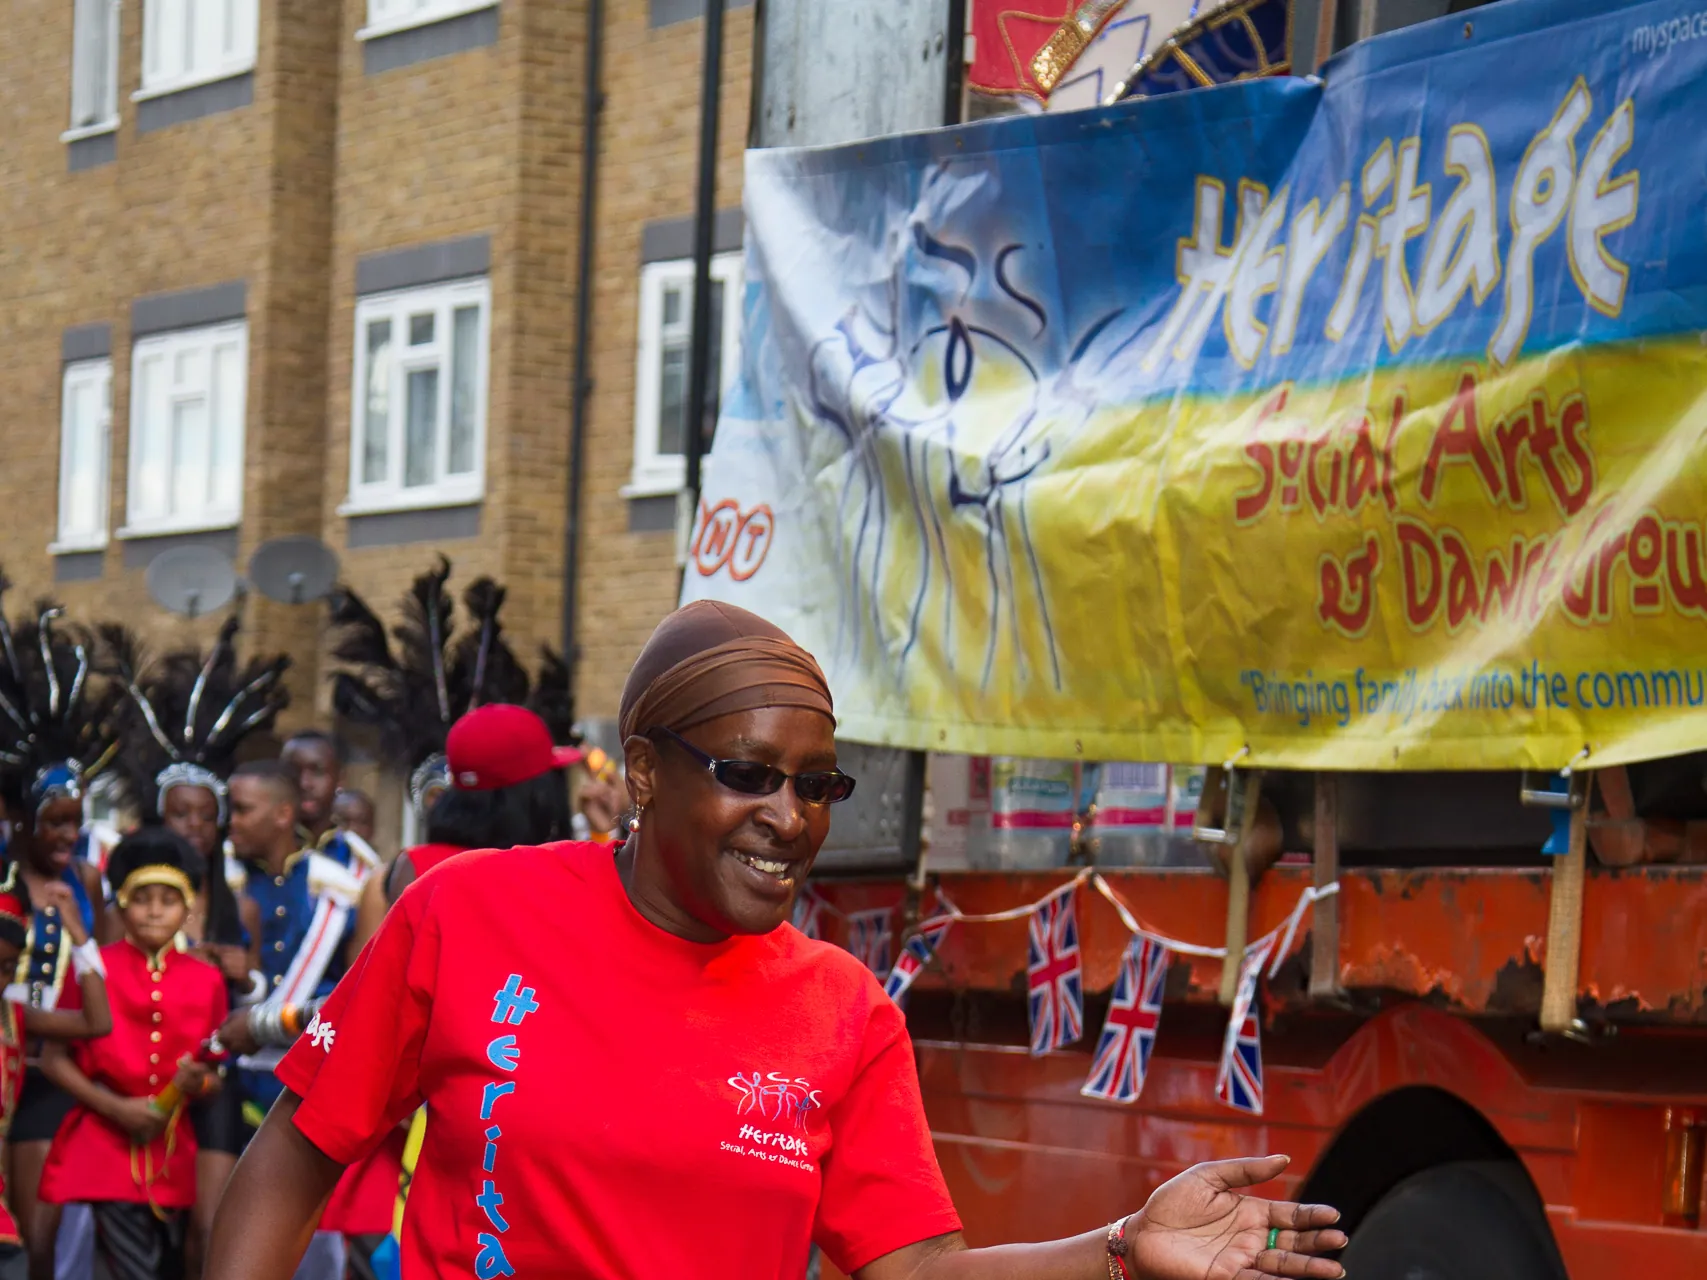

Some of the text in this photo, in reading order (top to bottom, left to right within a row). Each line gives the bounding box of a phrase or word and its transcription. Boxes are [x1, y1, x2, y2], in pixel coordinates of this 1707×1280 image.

[1235, 369, 1597, 521] Social Arts
[1354, 667, 1419, 727] family
[1469, 666, 1515, 710] into
[1521, 658, 1569, 709] the
[1576, 668, 1706, 707] commu
[720, 1140, 746, 1156] Social,
[747, 1148, 767, 1161] Arts
[738, 1123, 809, 1156] Heritage
